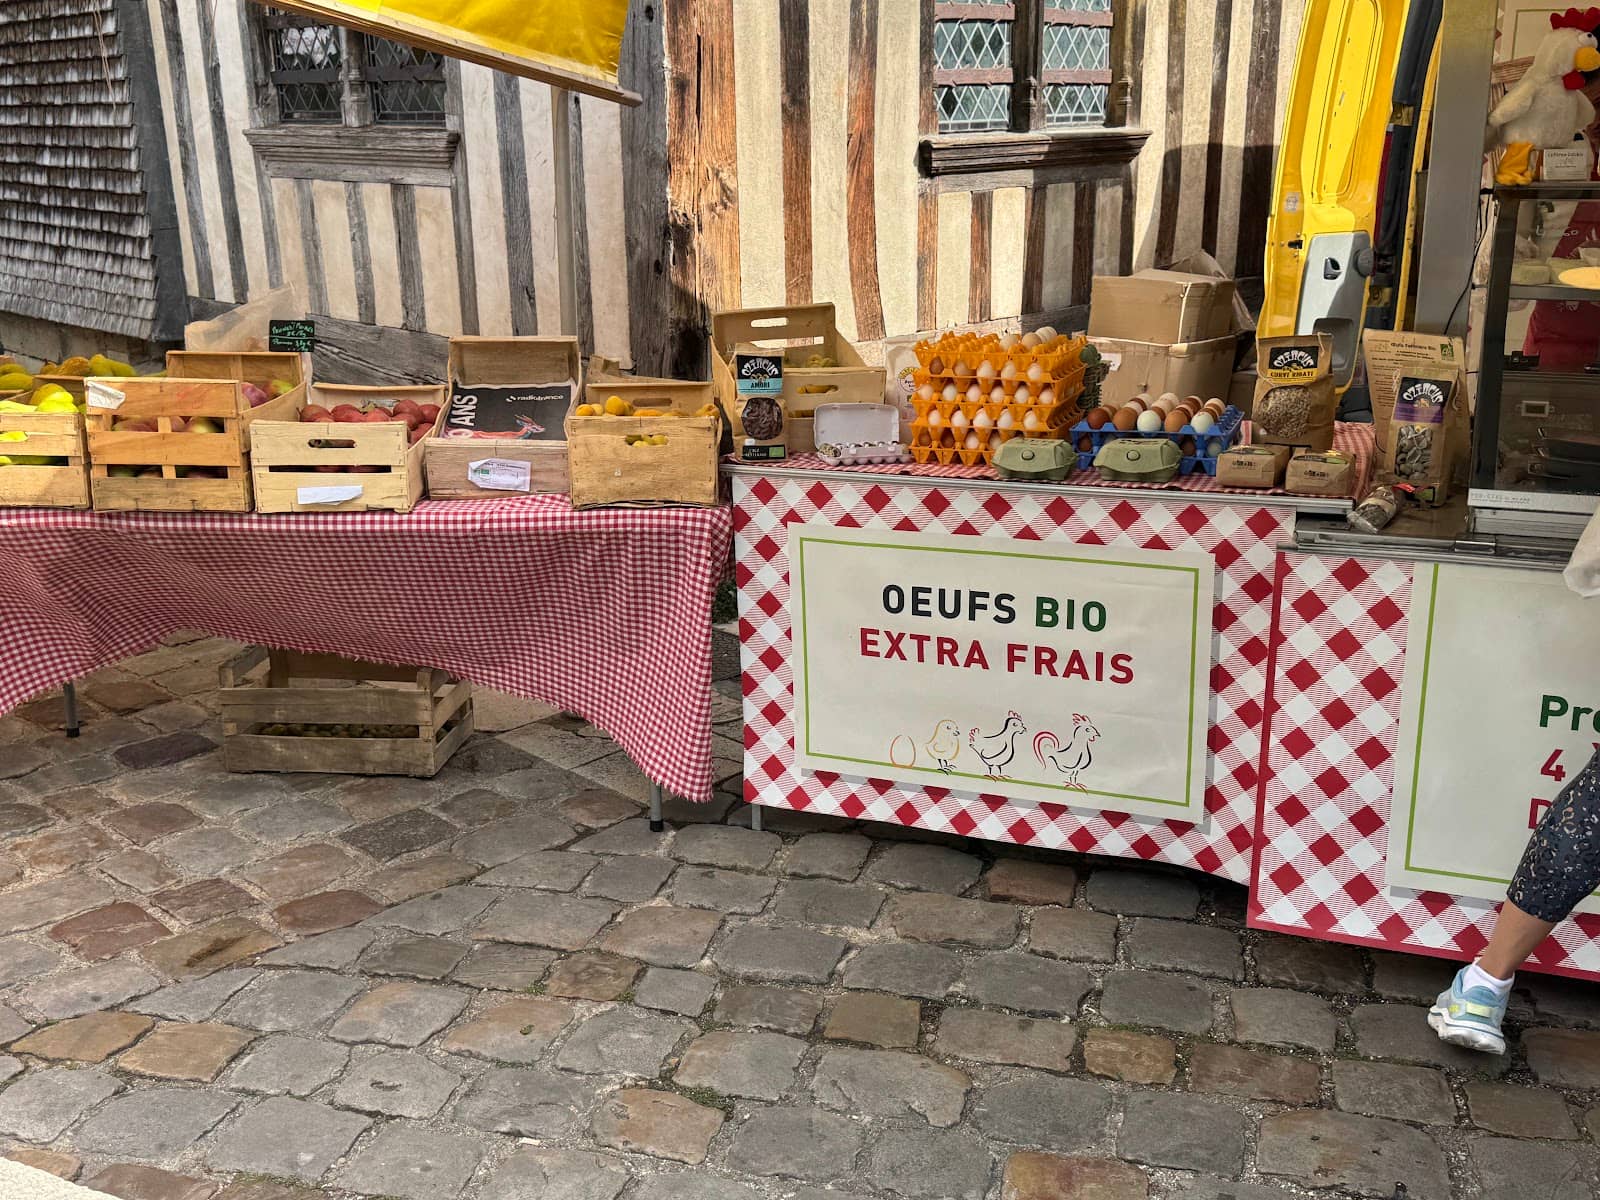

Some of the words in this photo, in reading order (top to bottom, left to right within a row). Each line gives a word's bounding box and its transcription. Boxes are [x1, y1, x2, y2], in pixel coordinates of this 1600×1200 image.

[450, 394, 478, 426] ANS
[882, 584, 1016, 624] OEUFS
[1035, 596, 1107, 632] BIO
[860, 627, 990, 670] EXTRA
[1007, 643, 1134, 684] FRAIS
[1540, 749, 1566, 782] 4
